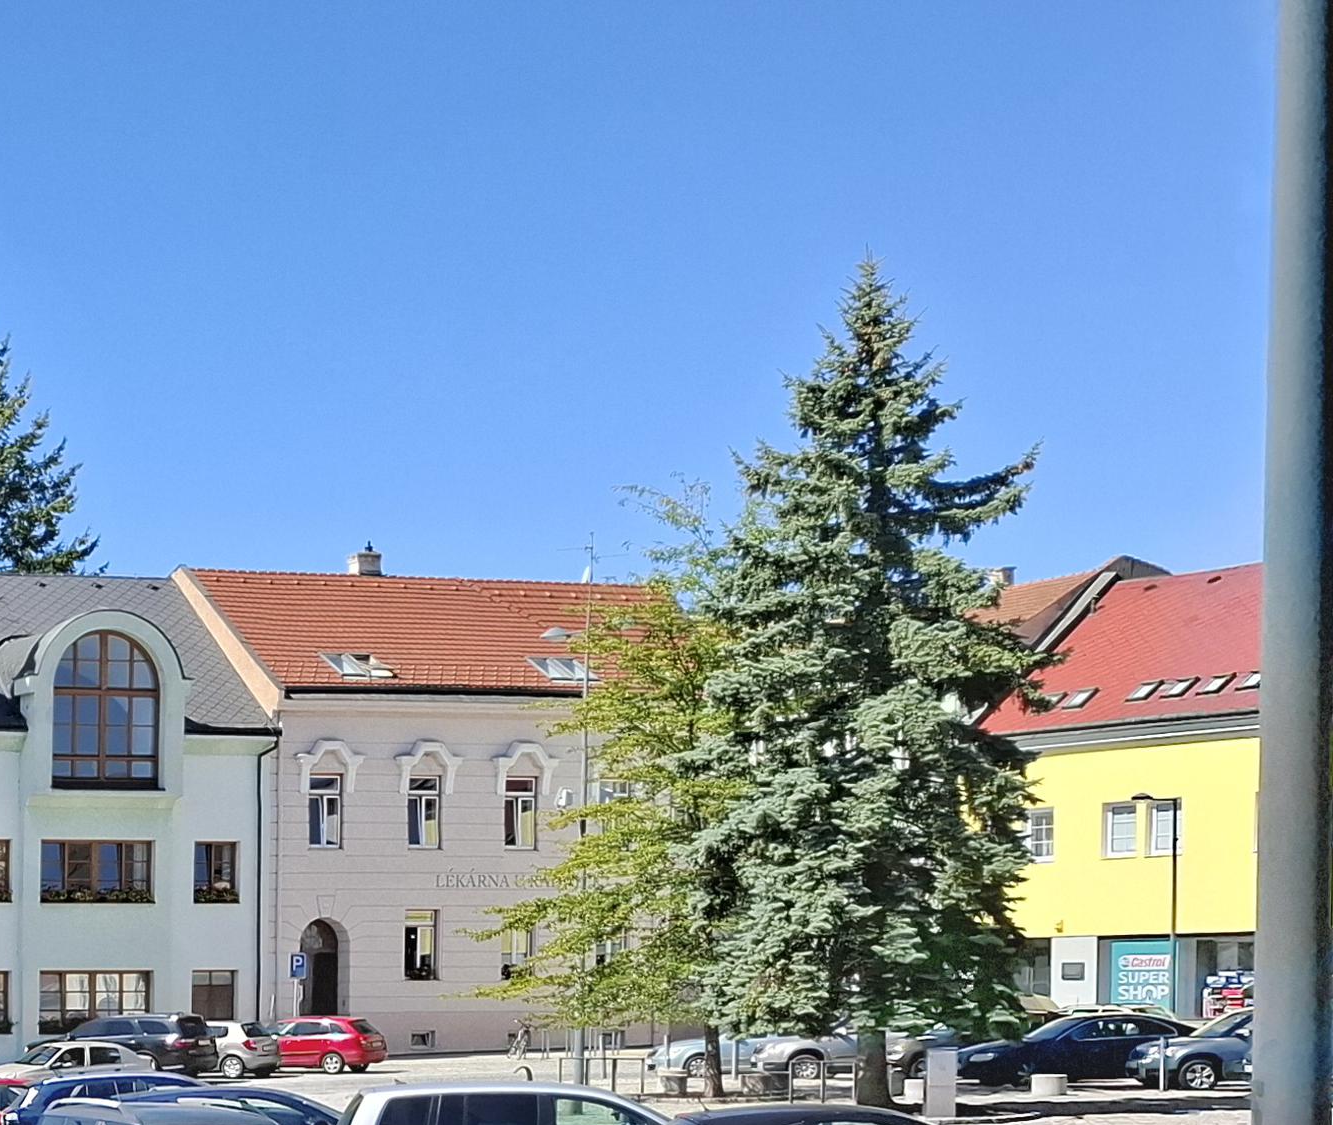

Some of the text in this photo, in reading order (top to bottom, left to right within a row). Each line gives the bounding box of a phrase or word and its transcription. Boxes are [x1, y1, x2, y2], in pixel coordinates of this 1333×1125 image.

[435, 868, 510, 889] LÉKÁRNA
[292, 955, 303, 971] P
[1131, 956, 1166, 968] Castrol
[1117, 971, 1170, 984] SUPER
[1117, 984, 1170, 1001] SHOP
